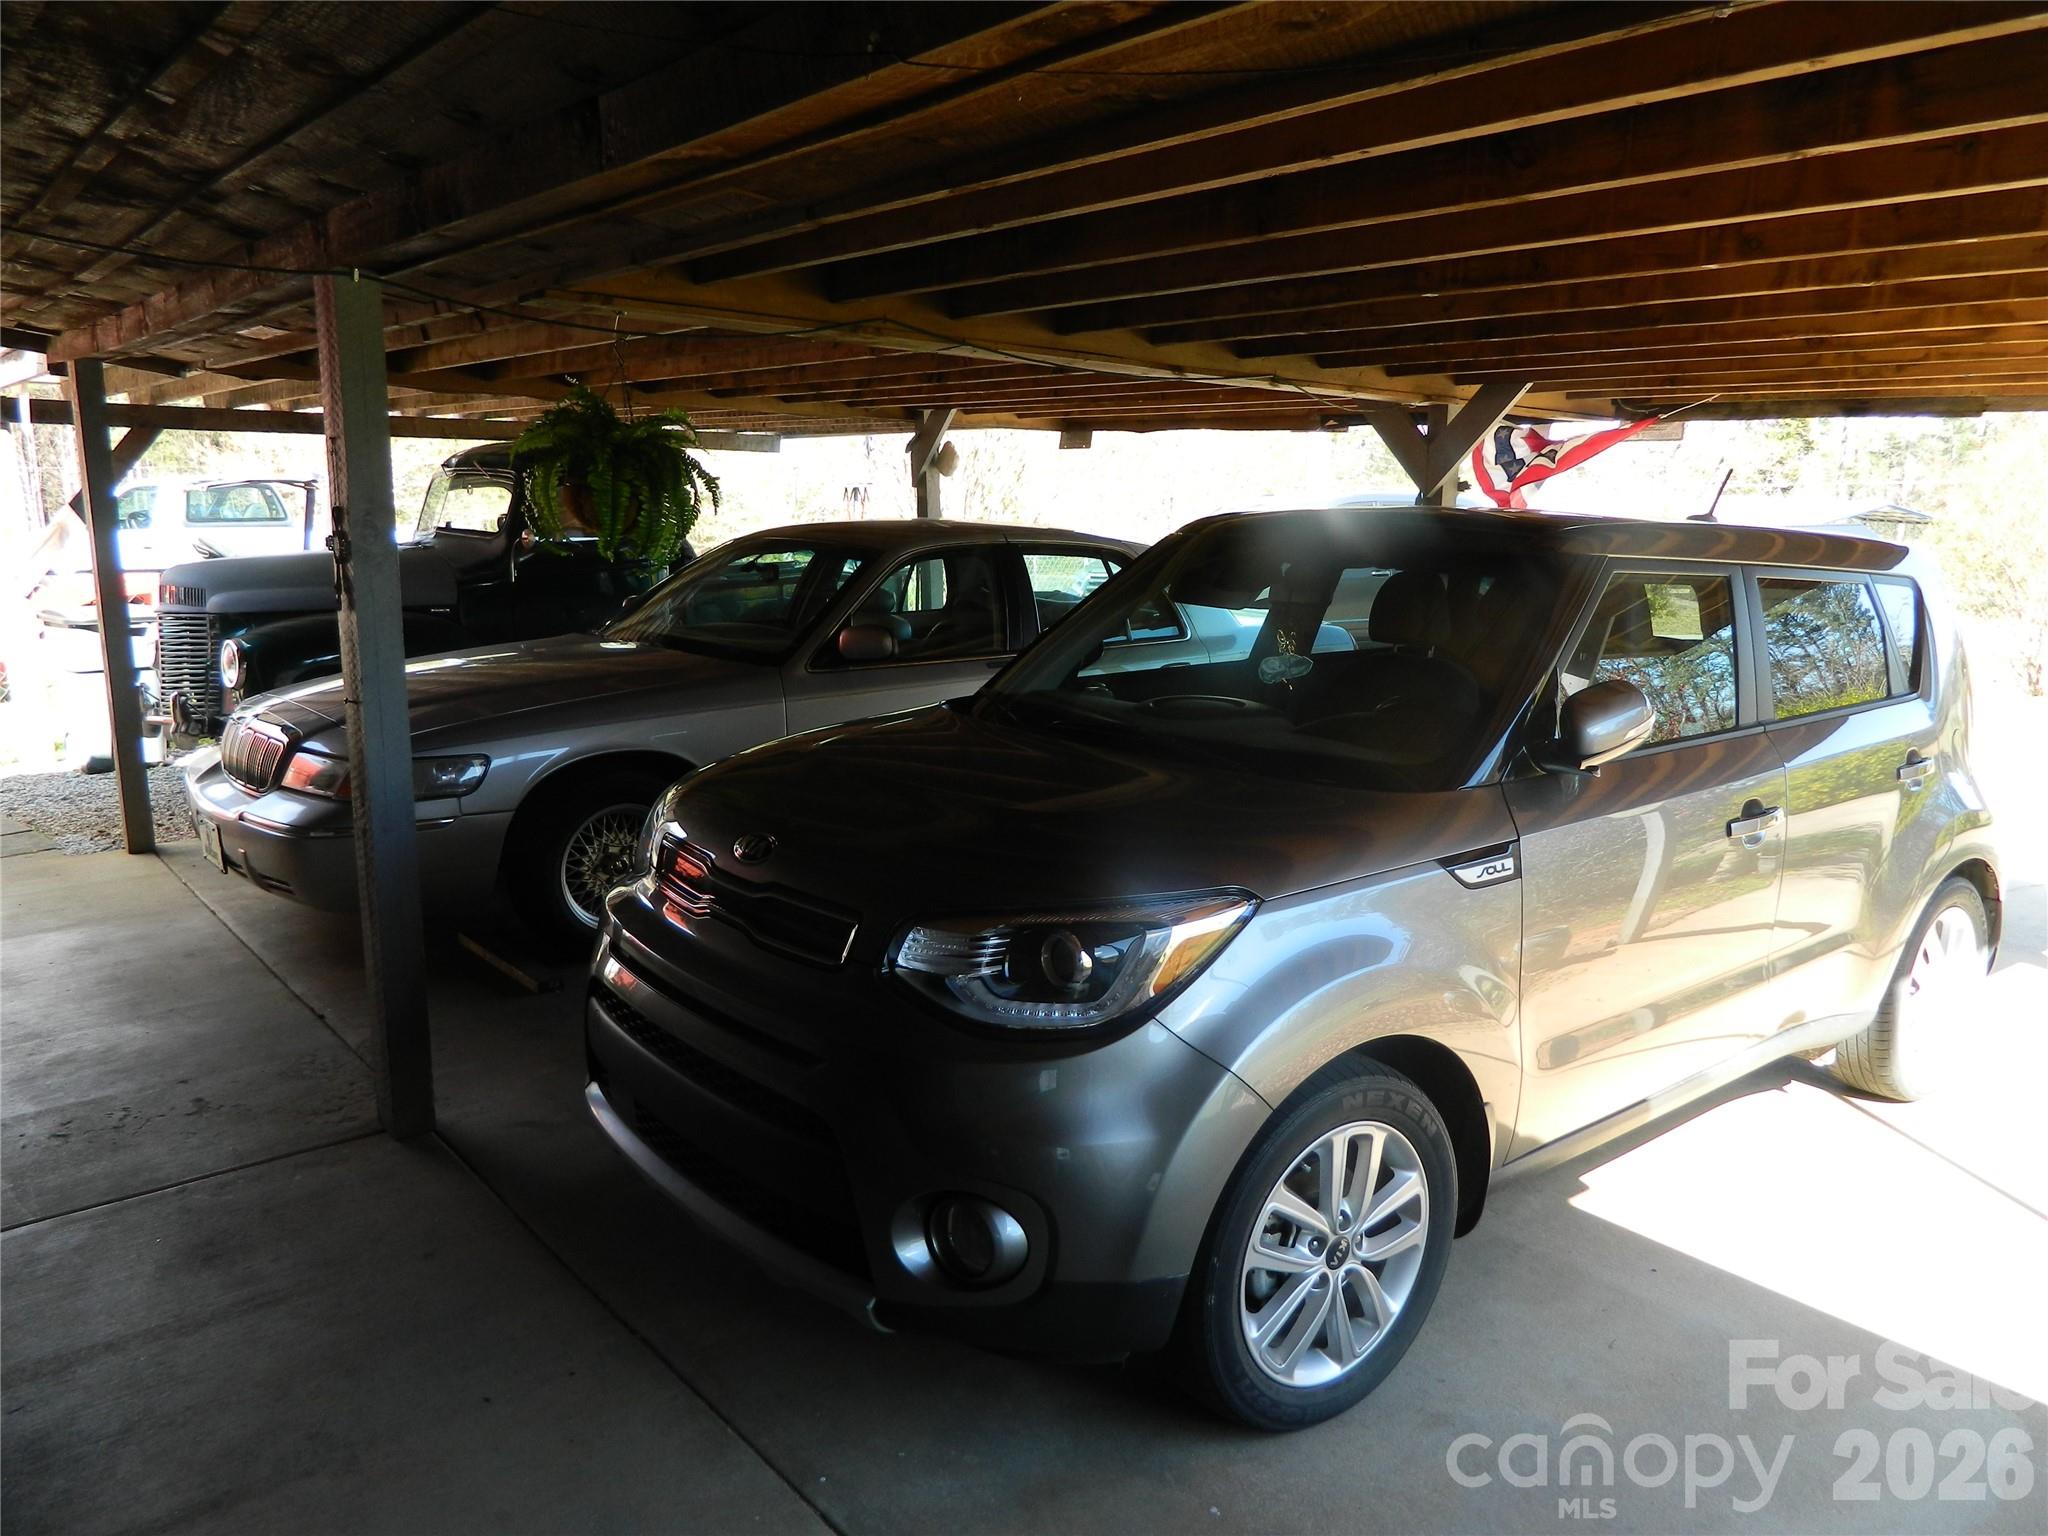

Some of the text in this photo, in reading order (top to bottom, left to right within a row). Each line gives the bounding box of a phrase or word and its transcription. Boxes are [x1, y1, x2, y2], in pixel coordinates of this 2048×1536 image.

[1476, 862, 1512, 879] SOUL
[1341, 1089, 1438, 1137] NEXEN
[1330, 1238, 1348, 1265] KIA
